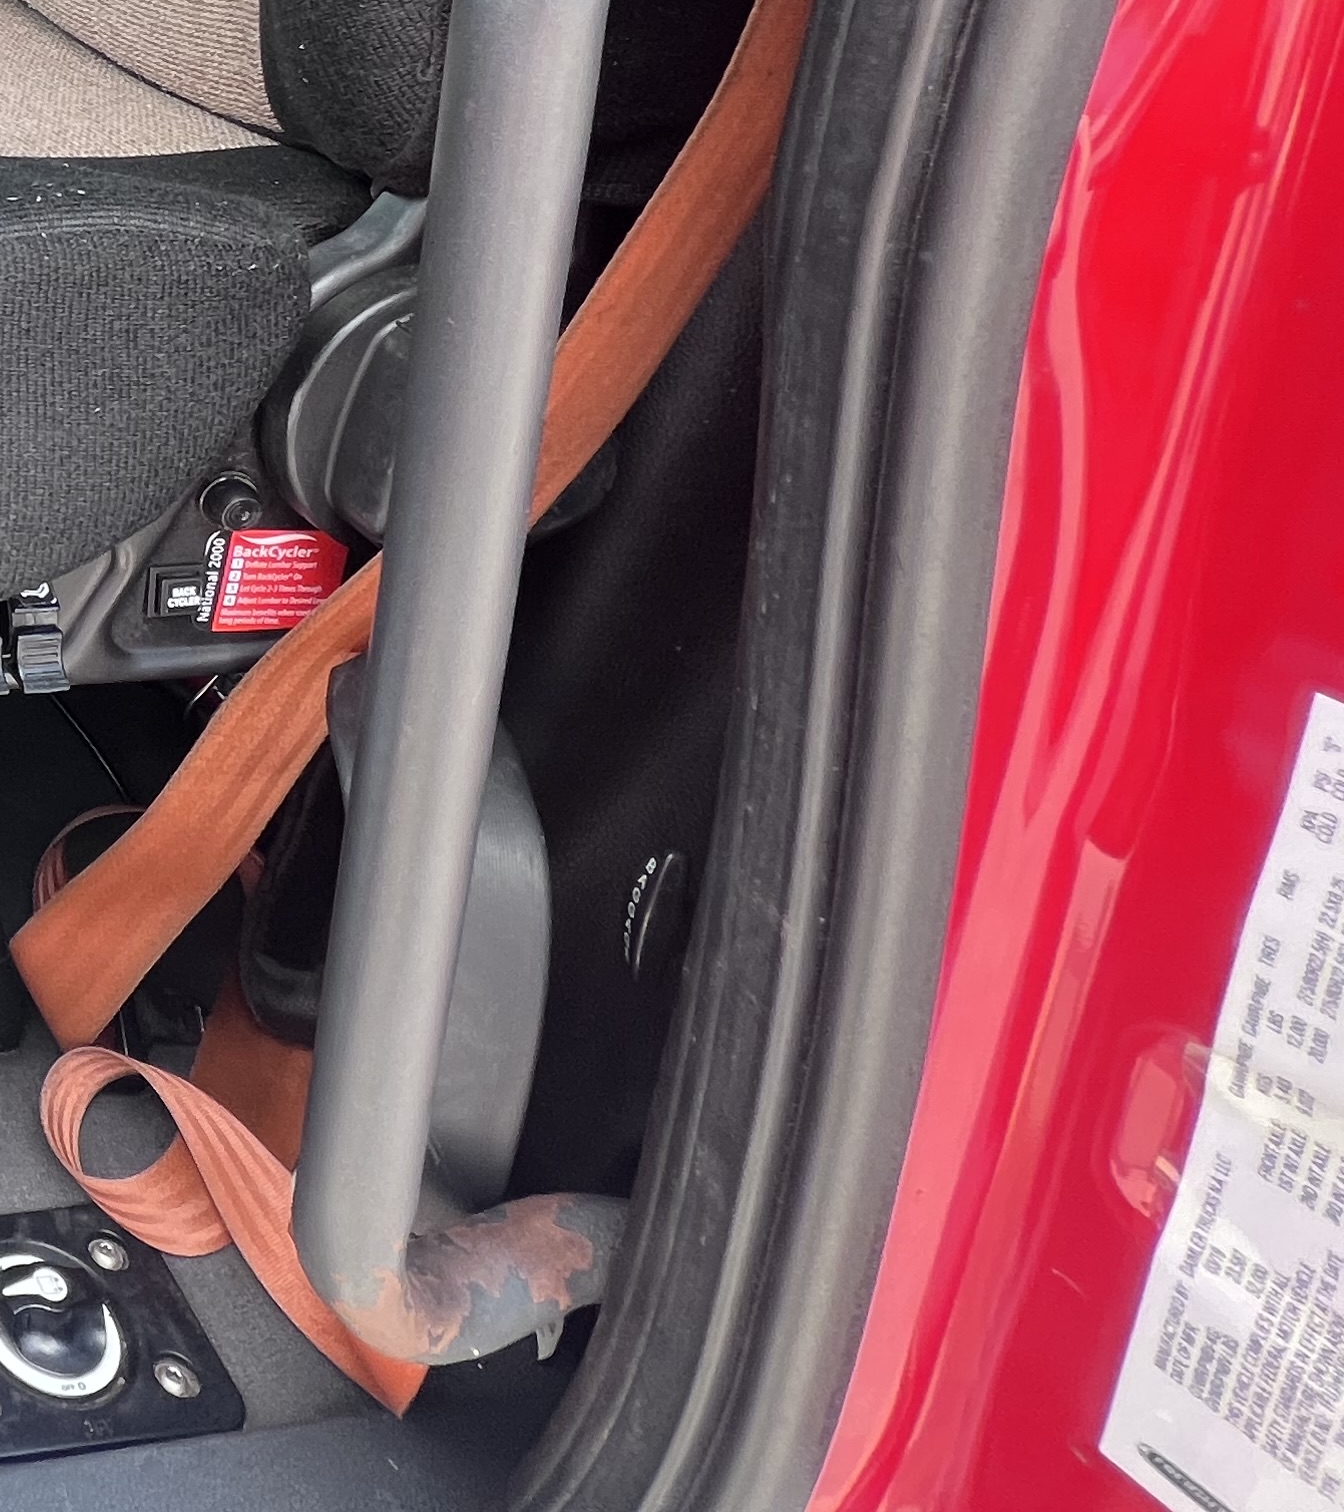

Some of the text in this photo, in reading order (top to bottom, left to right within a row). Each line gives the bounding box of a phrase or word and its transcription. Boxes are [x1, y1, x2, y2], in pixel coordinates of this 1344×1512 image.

[196, 537, 226, 623] National 2000
[172, 586, 197, 598] BACK
[167, 595, 202, 609] CYCLER
